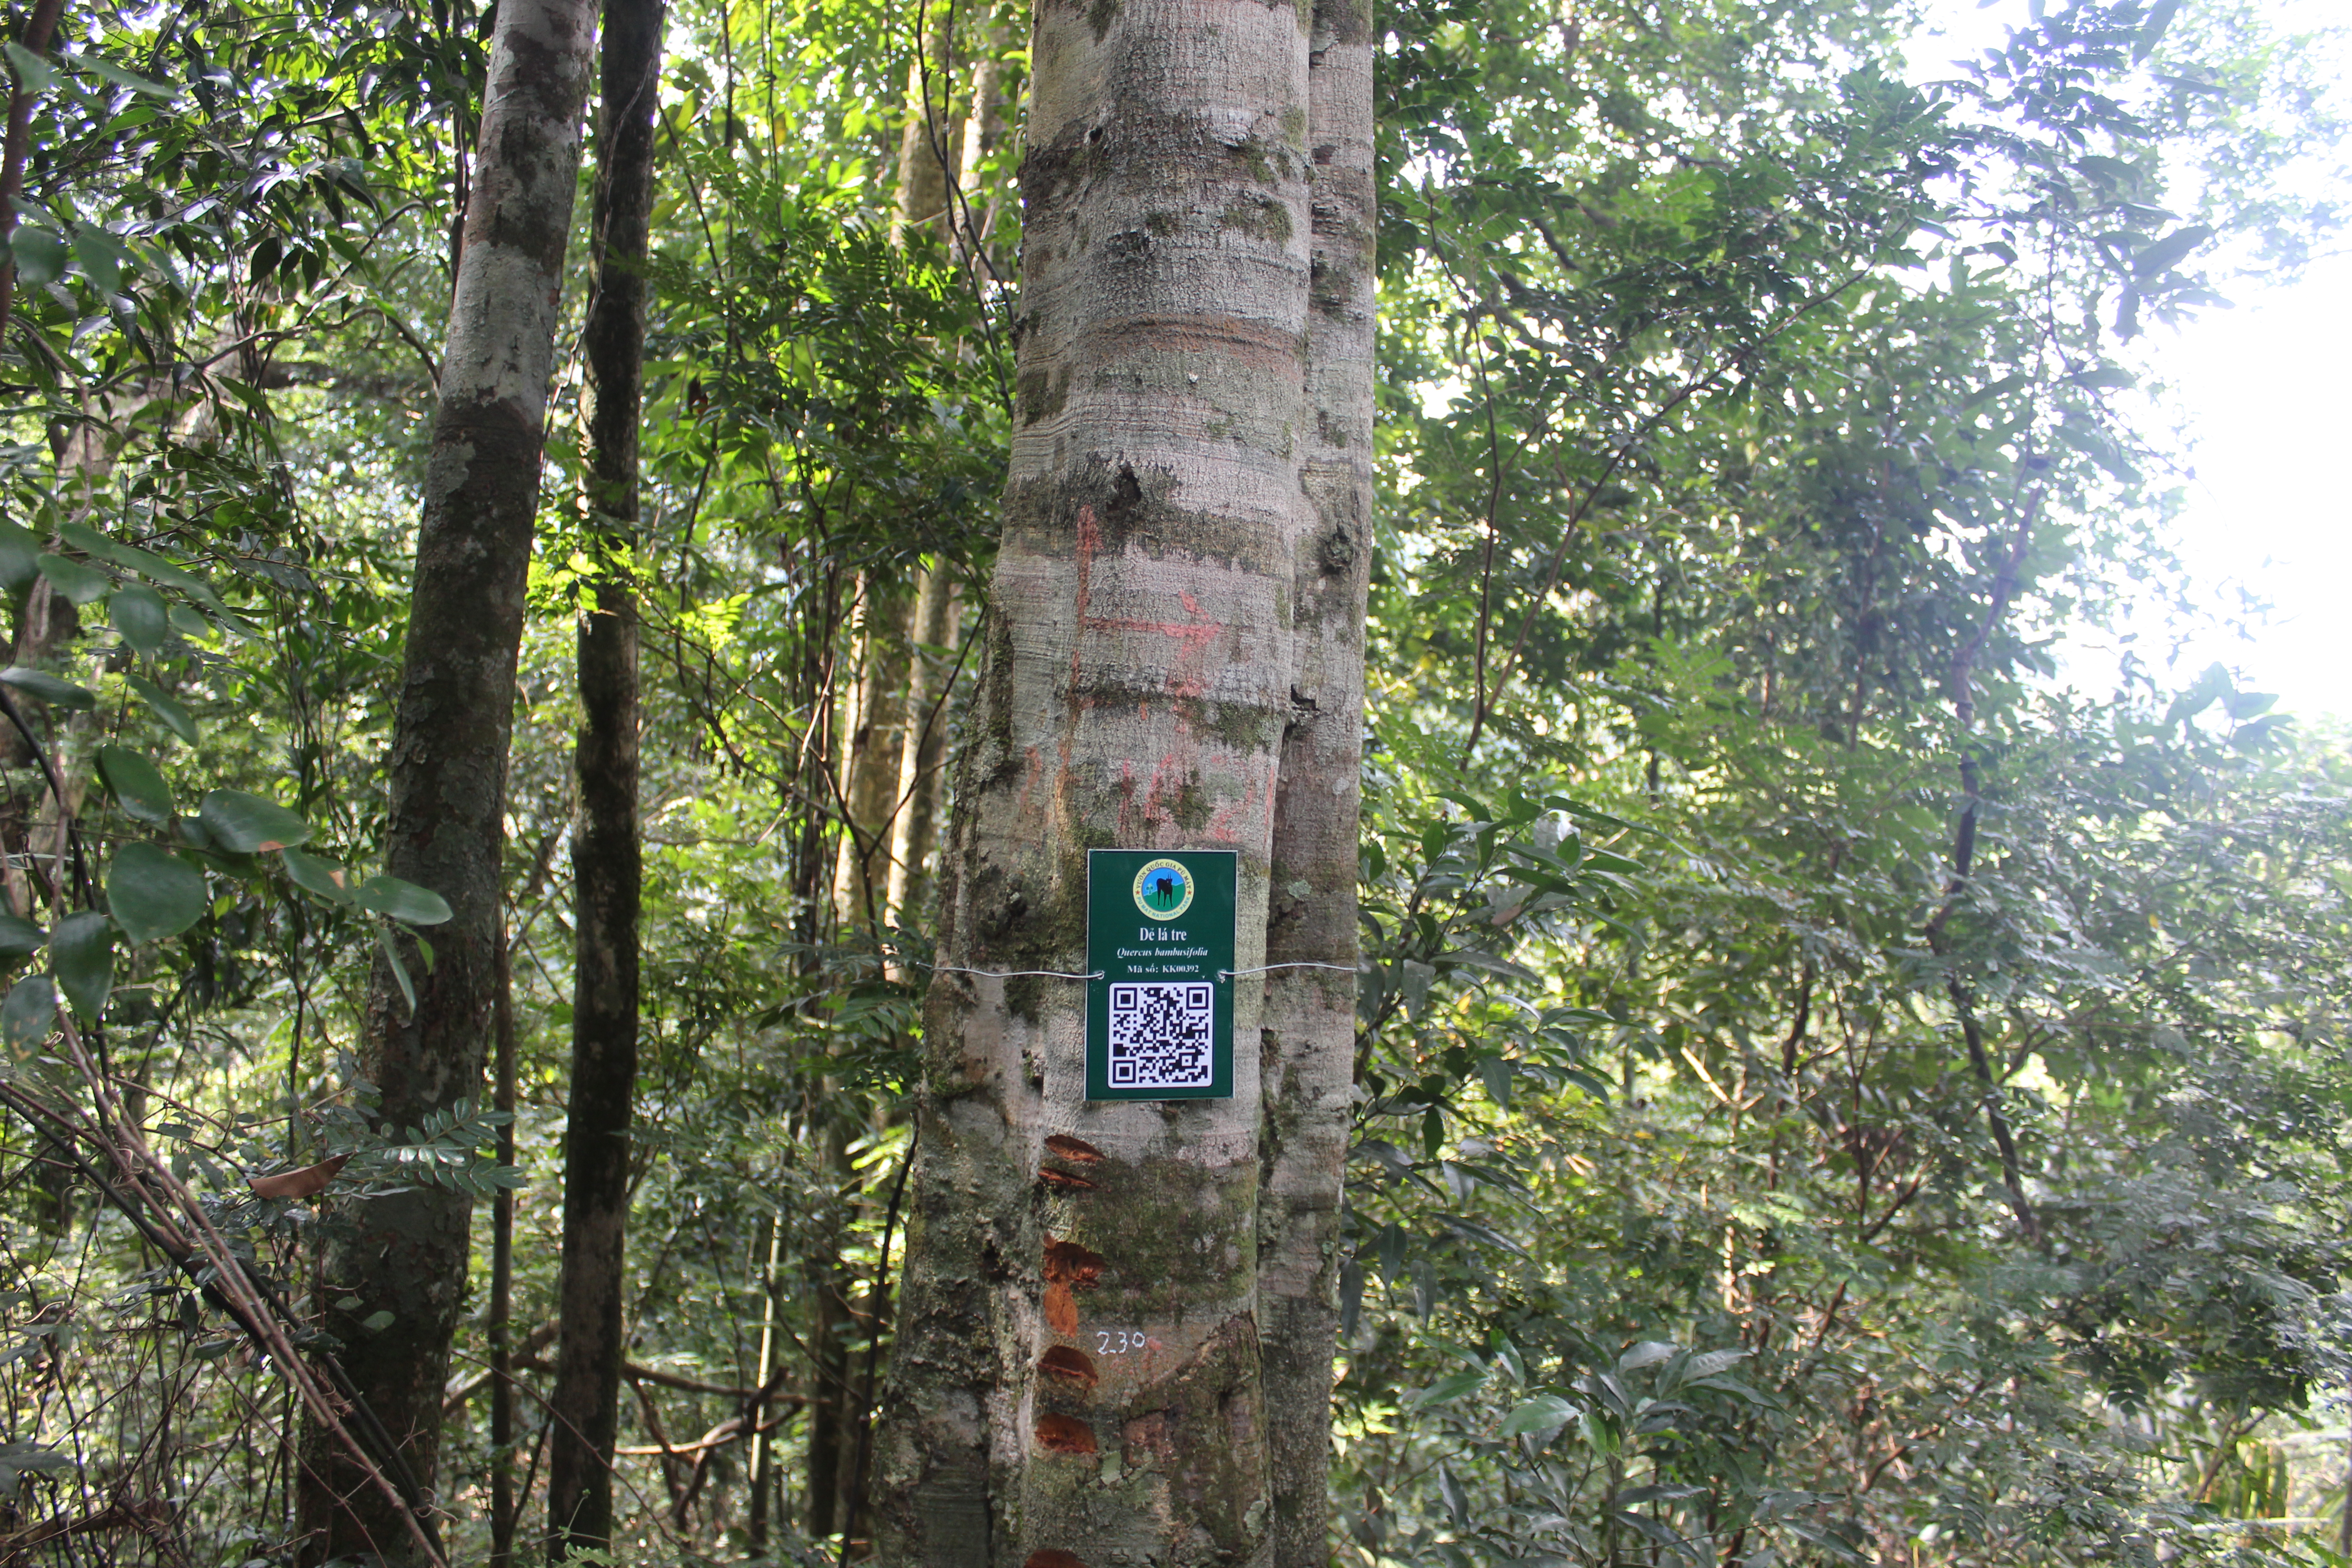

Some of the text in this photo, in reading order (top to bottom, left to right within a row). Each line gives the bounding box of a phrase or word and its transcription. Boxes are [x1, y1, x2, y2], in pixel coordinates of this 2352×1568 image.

[1147, 861, 1164, 872] QUỐC
[1141, 904, 1152, 914] MAT
[1152, 910, 1180, 918] NATIONAL
[1180, 897, 1191, 911] PARK
[1140, 927, 1187, 941] Dẻ lá tre
[1117, 947, 1208, 959] Quercus bambusifolia
[1127, 963, 1199, 973] Mã số: KK00392
